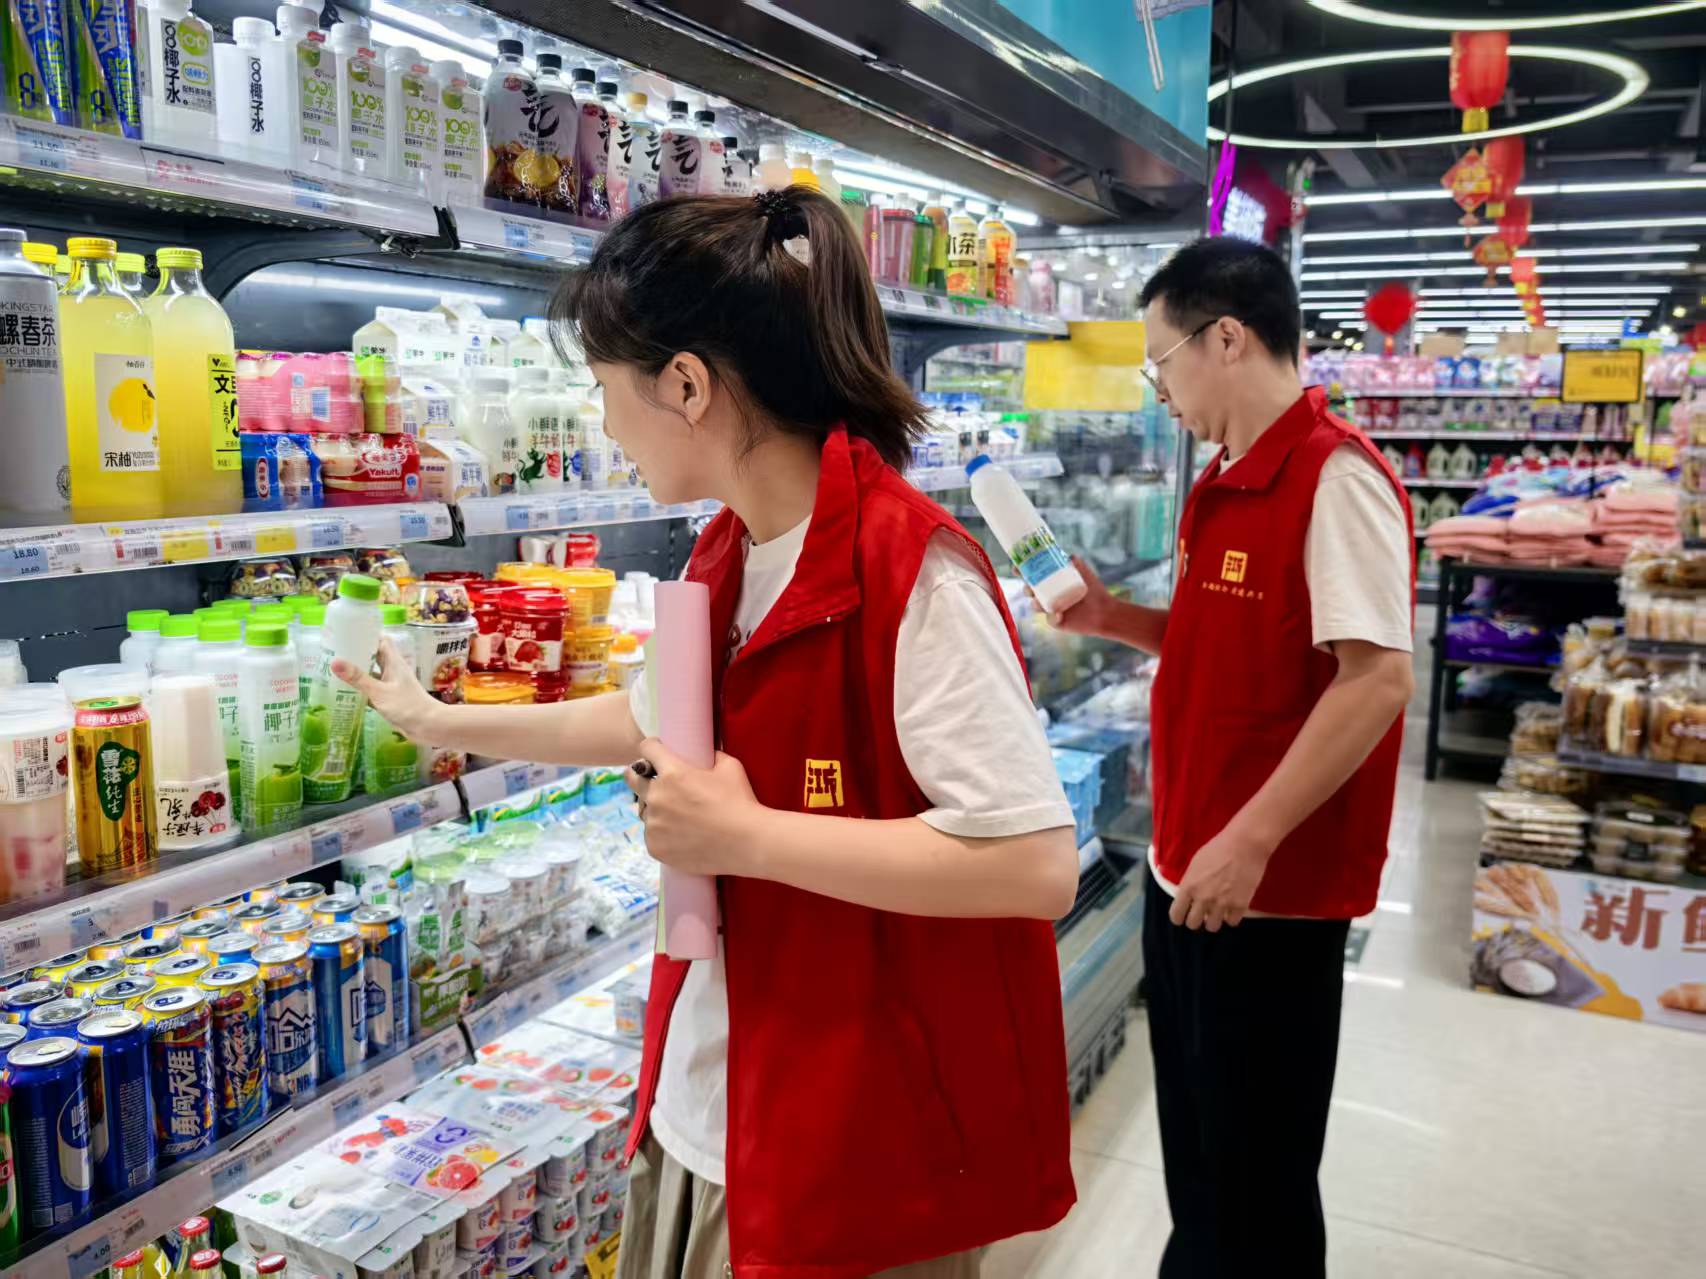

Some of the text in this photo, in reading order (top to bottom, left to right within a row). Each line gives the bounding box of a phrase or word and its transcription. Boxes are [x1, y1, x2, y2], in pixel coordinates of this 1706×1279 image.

[104, 452, 131, 468] 宋柚
[168, 1050, 200, 1136] 勇闯天涯
